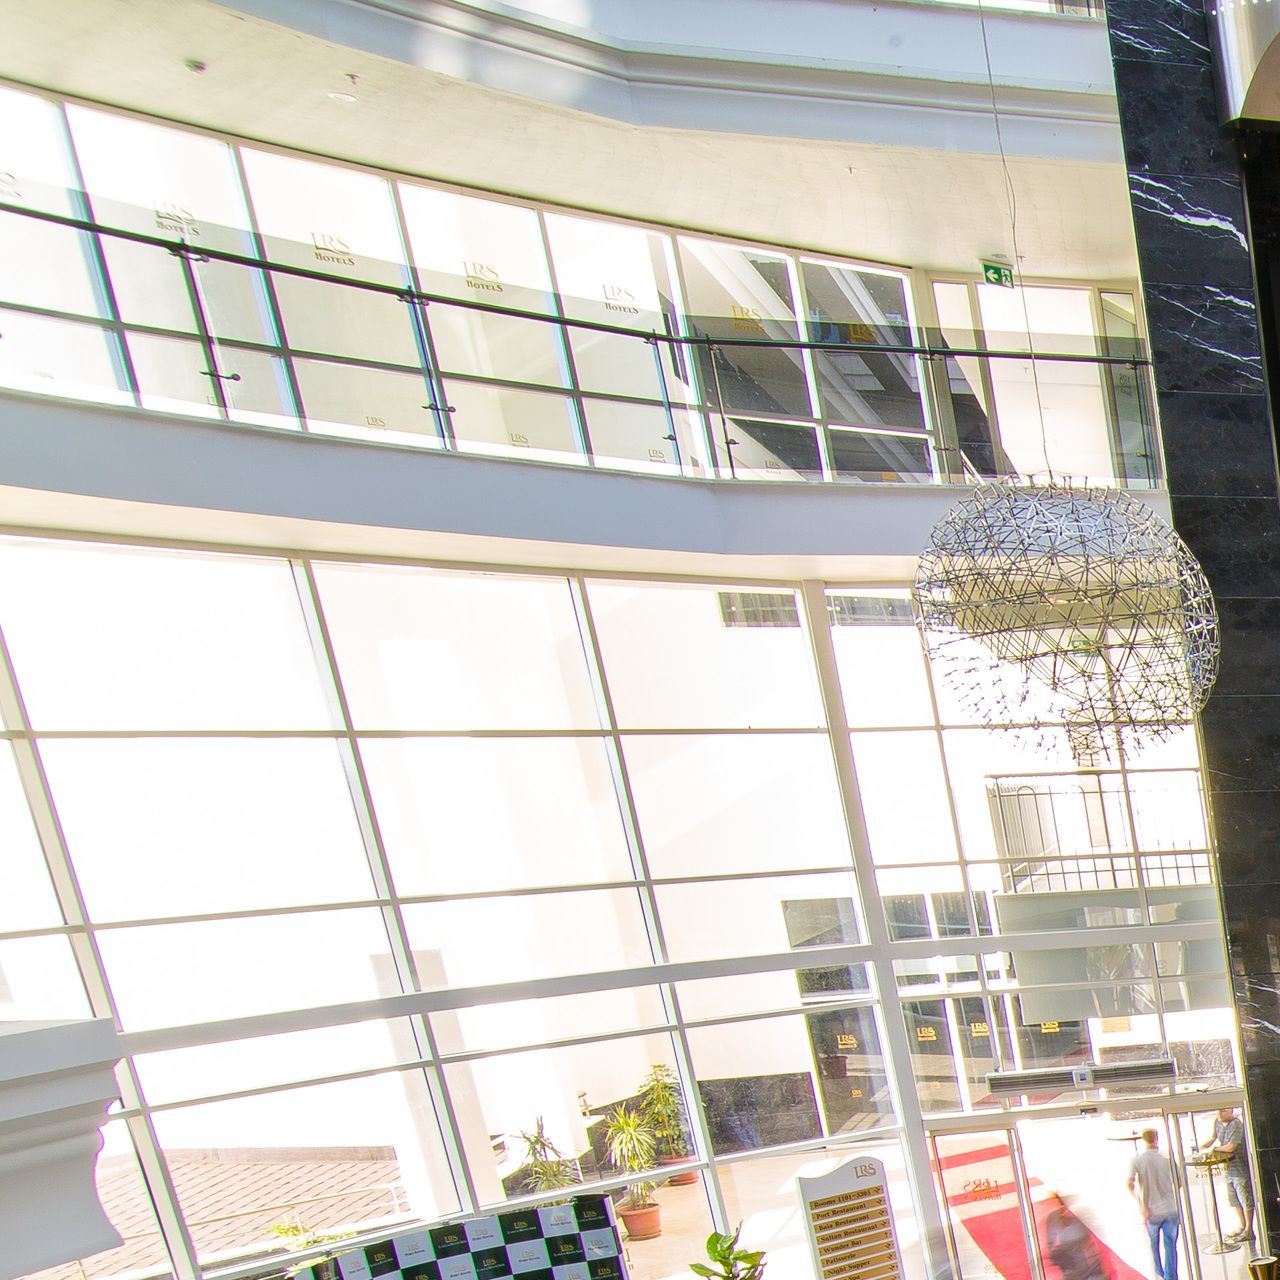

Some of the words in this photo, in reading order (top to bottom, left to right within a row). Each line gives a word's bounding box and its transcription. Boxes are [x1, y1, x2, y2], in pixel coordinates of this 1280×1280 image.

[853, 1163, 877, 1180] LRS
[814, 1199, 836, 1208] Rooms
[816, 1211, 830, 1219] Port
[832, 1203, 866, 1215] Restaurant
[835, 1214, 870, 1226] Restaurant
[821, 1233, 842, 1242] Sultan
[844, 1224, 878, 1236] Restaurant
[823, 1243, 849, 1253] Wunder
[825, 1253, 856, 1265] Patisserie
[827, 1267, 846, 1275] Night
[848, 1260, 870, 1269] Supper
